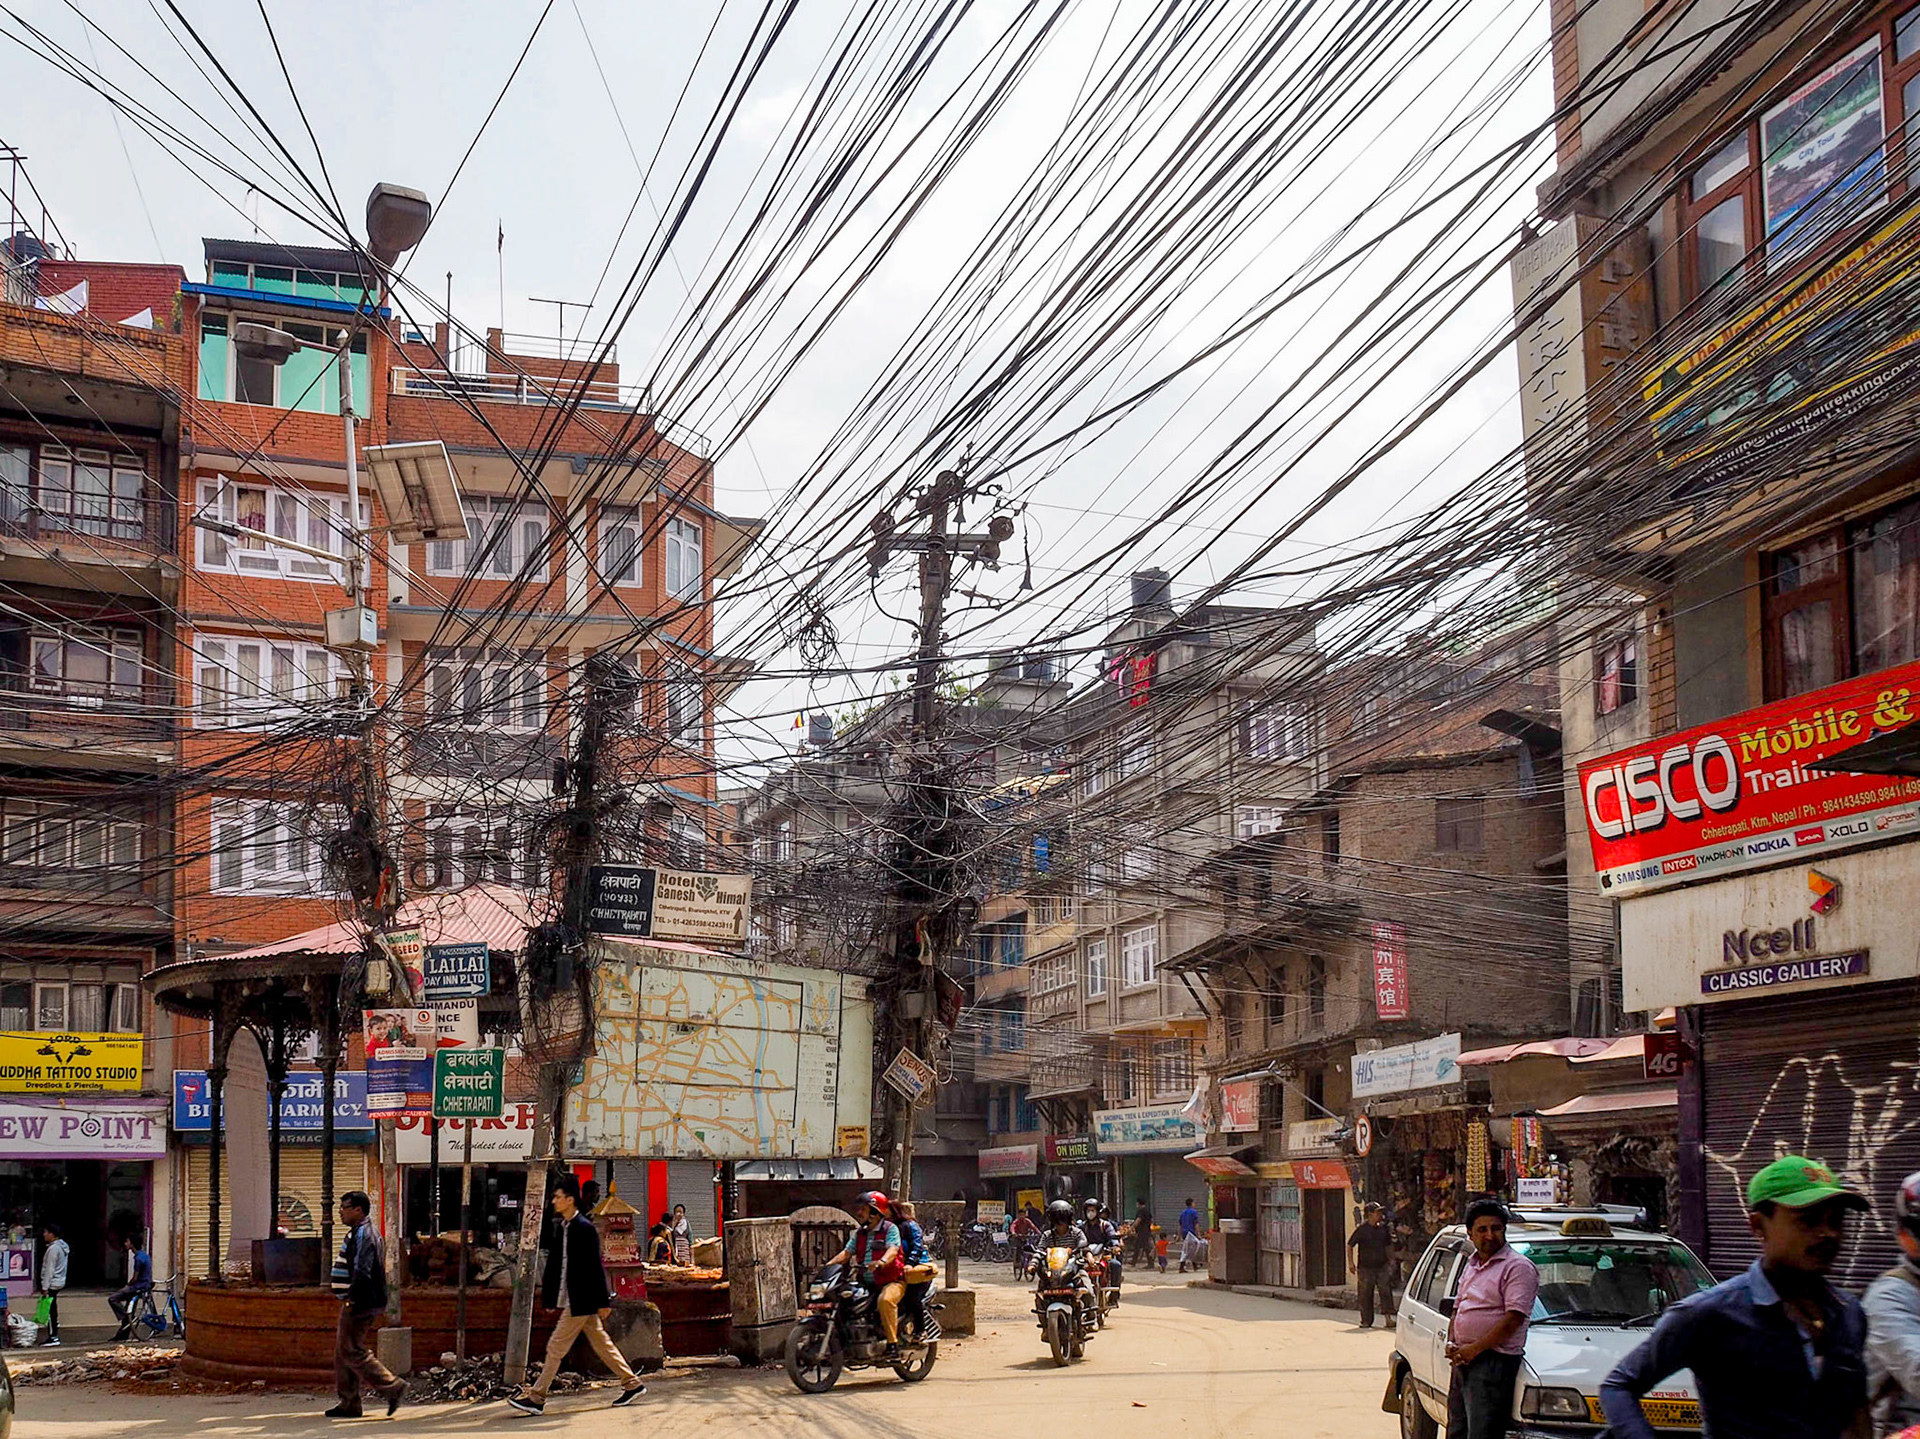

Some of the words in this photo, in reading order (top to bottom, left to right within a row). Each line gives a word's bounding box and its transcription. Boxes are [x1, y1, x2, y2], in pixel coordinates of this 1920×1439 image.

[1798, 144, 1816, 161] City
[1816, 131, 1837, 150] Tour
[1737, 708, 1862, 764] Mobile
[1872, 688, 1915, 727] &
[1585, 734, 1738, 838] CISCO
[1771, 808, 1797, 825] Nepal
[1829, 822, 1869, 838] XOLO
[1747, 836, 1791, 855] NOKIA
[1696, 846, 1744, 866] SYMPHONY
[658, 872, 696, 888] Hotel
[1616, 865, 1660, 885] SAMSUNG
[657, 885, 696, 902] Ganesh
[716, 891, 747, 905] Himal
[654, 915, 666, 923] TEL
[1722, 915, 1817, 965] Ncell
[442, 974, 459, 985] INN
[1709, 967, 1774, 991] CLASSIC
[1777, 956, 1852, 982] GALLERY
[426, 1000, 475, 1010] HMANDU
[437, 1025, 456, 1033] TEL
[49, 1035, 81, 1044] LORD
[1648, 1052, 1678, 1074] 4G
[46, 1066, 92, 1080] TATTOO
[96, 1066, 138, 1080] STUDIO
[443, 1071, 494, 1090] क्षेत्रपाटी
[1355, 1059, 1375, 1086] HIS
[25, 1081, 63, 1089] Dreadlock
[65, 1081, 71, 1089] &
[73, 1081, 104, 1090] Piercing
[442, 1095, 494, 1112] CHHETRAPATI
[448, 1140, 464, 1151] The
[497, 1140, 524, 1151] choice
[1056, 1145, 1068, 1157] ON
[1069, 1143, 1089, 1156] HIRE
[1303, 1165, 1317, 1184] 4G
[1574, 1219, 1606, 1232] TAXI
